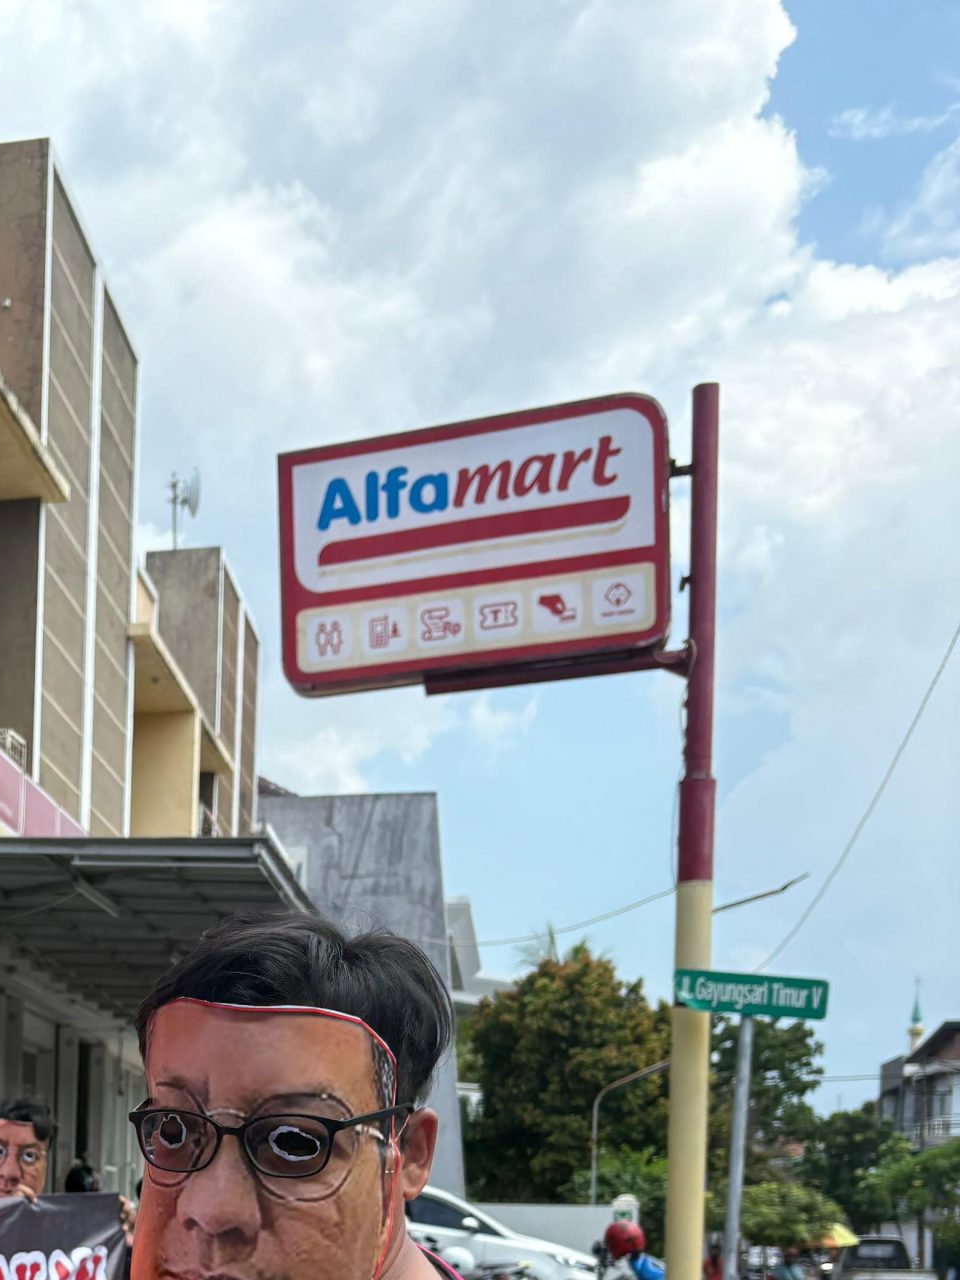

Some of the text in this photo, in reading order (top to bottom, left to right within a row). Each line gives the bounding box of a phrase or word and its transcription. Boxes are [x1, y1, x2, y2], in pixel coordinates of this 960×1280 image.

[317, 435, 623, 531] Alfamart
[695, 976, 769, 1010] Gayungsari
[772, 983, 808, 1009] Timur
[811, 985, 824, 1010] V
